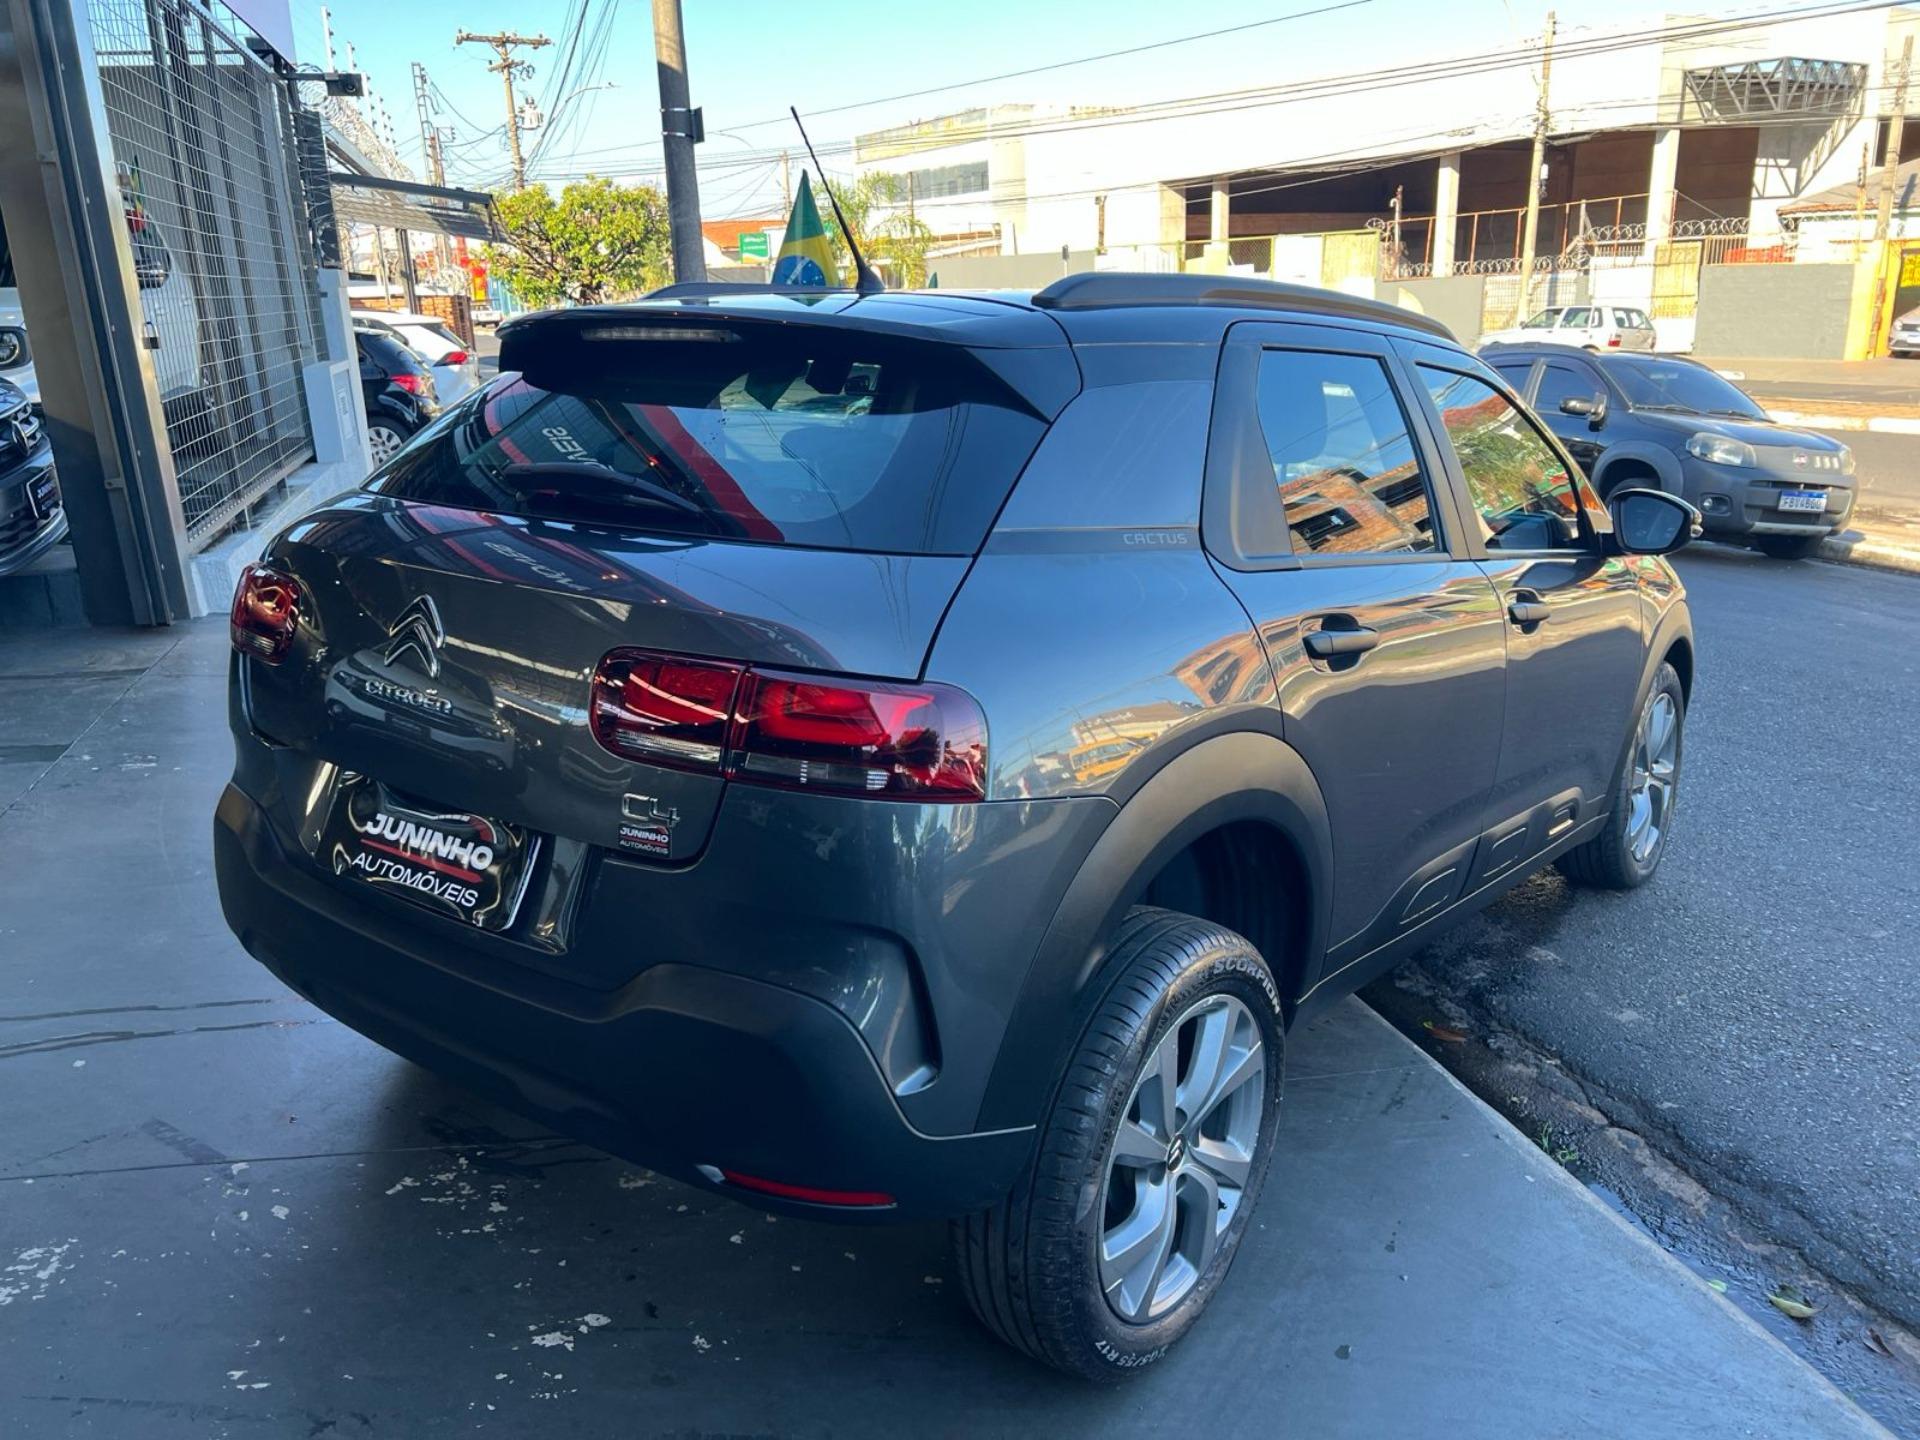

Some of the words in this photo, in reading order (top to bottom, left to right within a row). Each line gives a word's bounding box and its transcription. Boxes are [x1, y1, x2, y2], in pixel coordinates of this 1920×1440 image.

[1122, 532, 1189, 545] CACTUS
[622, 792, 680, 828] C4
[366, 812, 494, 871] JUNINHO
[619, 826, 669, 844] JUNINHO
[351, 851, 479, 908] AUTOMÓVEIS
[1212, 957, 1280, 1015] SCORPION
